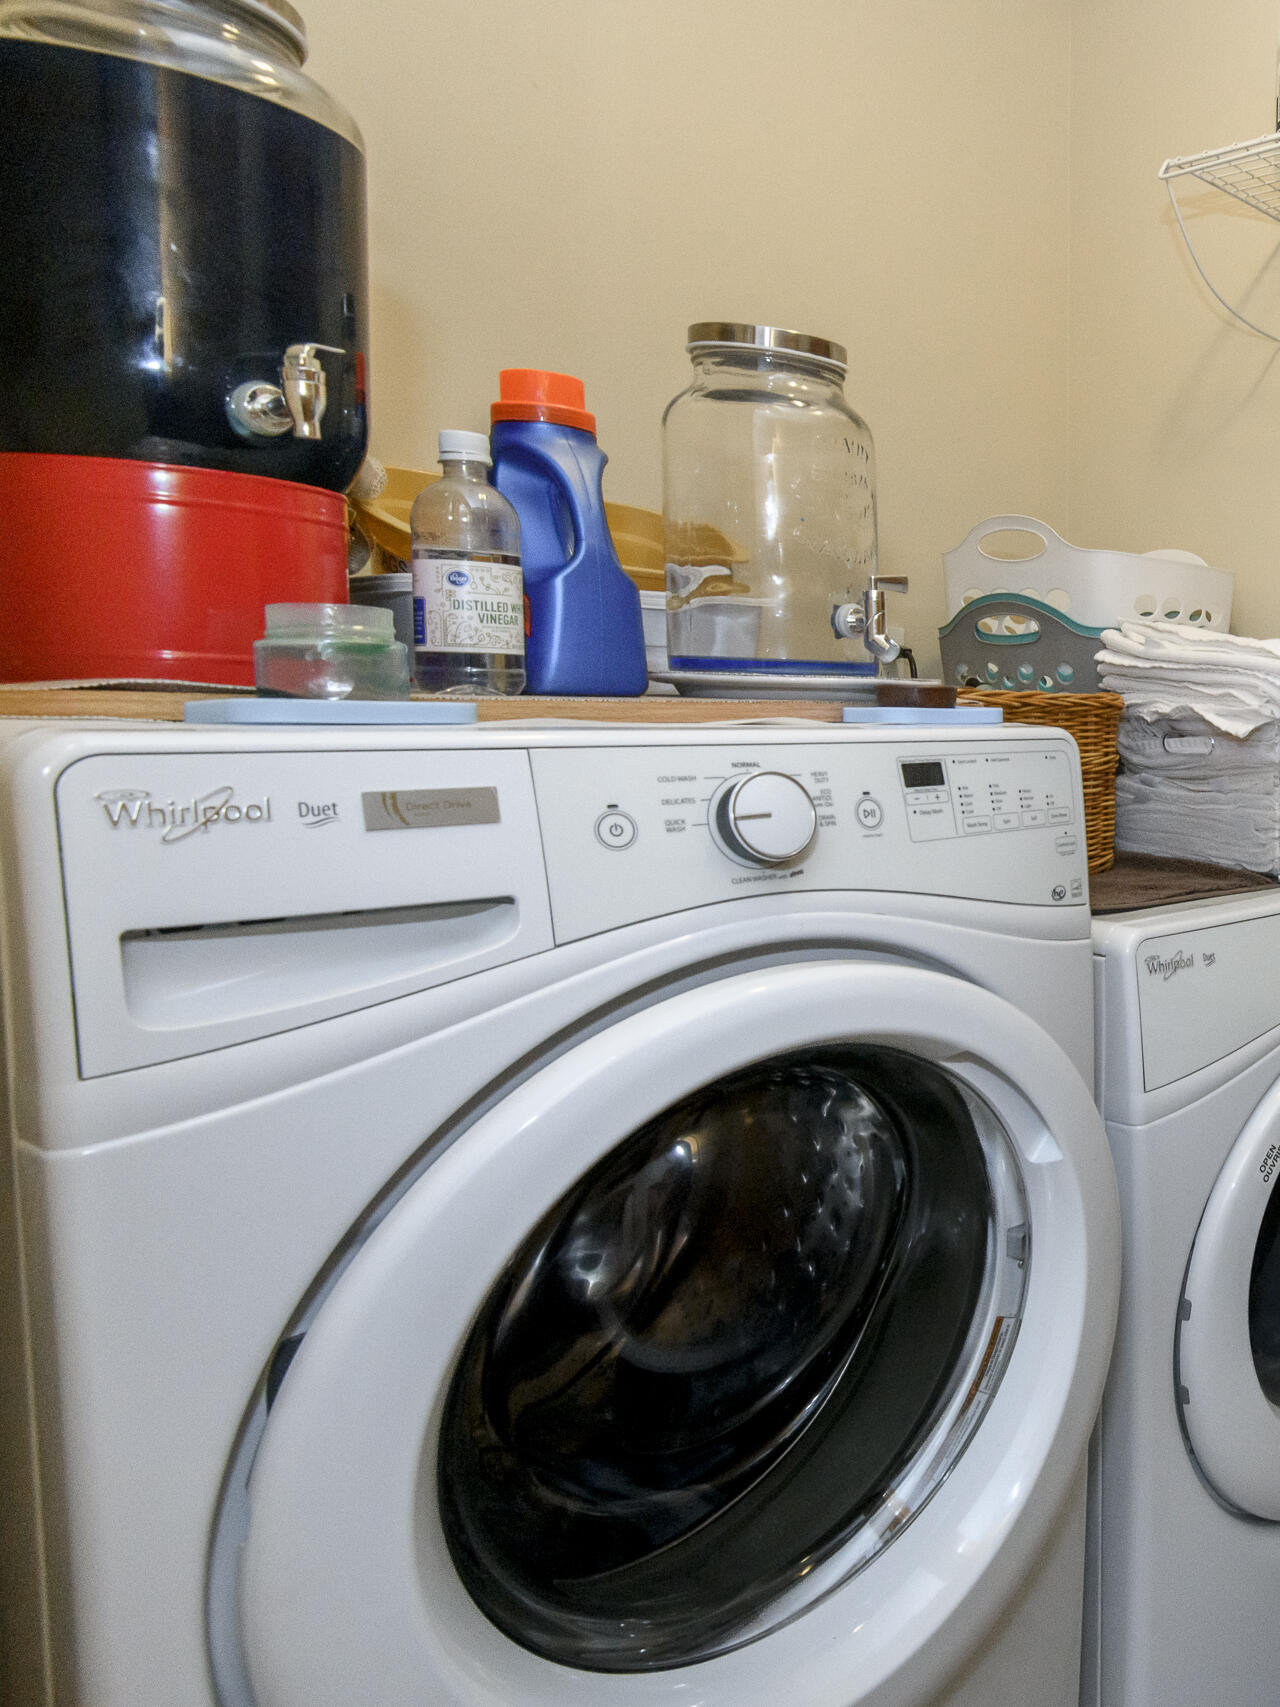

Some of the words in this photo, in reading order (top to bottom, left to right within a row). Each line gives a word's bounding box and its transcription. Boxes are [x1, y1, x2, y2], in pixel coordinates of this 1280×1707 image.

[453, 599, 508, 613] DISTILLED
[478, 613, 518, 625] VINEGAR
[98, 793, 273, 836] Whirlpool
[297, 801, 340, 819] Duet
[1146, 953, 1194, 977] Whirlpool
[1259, 1144, 1277, 1173] OPEN
